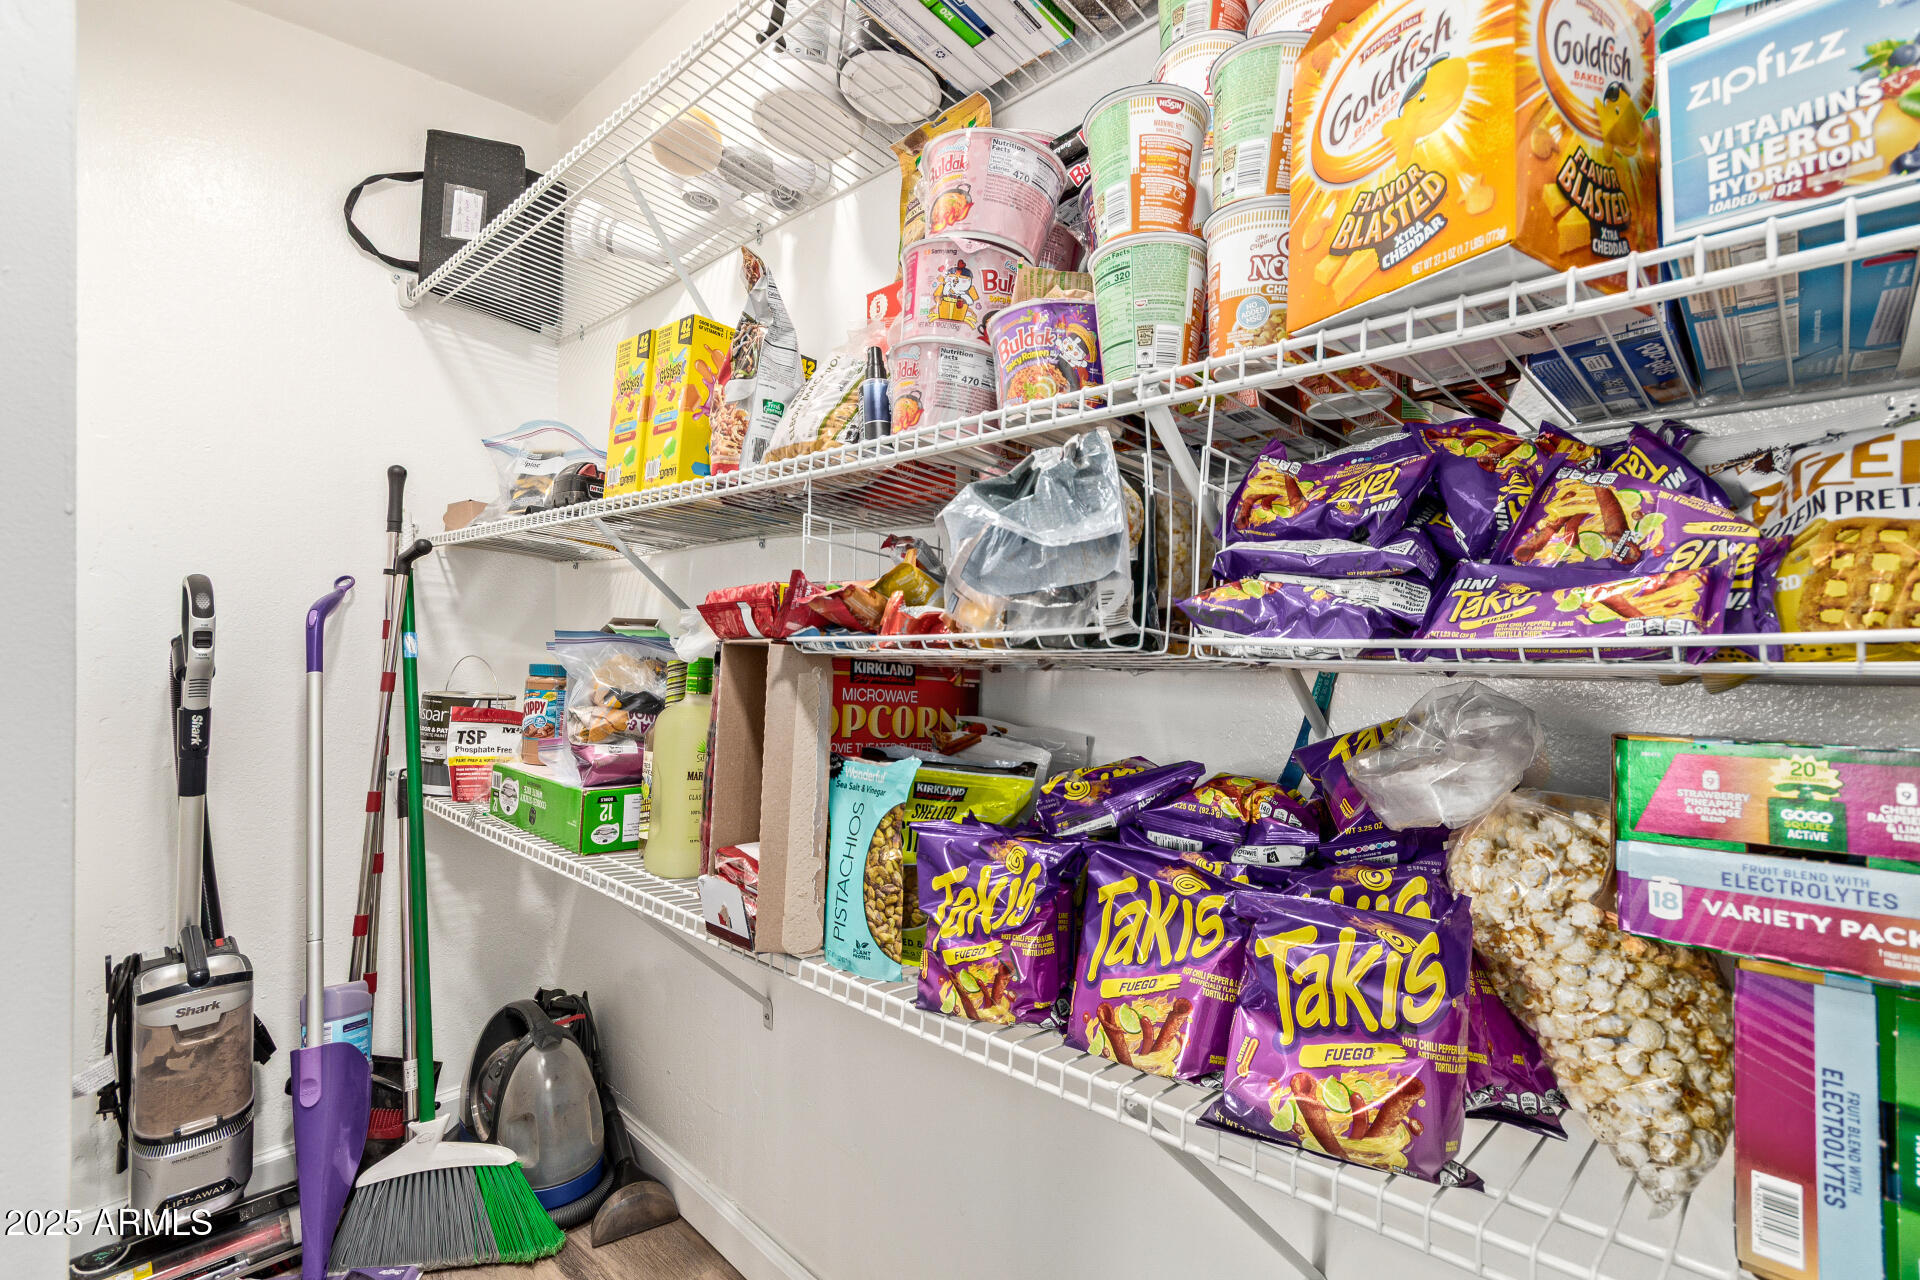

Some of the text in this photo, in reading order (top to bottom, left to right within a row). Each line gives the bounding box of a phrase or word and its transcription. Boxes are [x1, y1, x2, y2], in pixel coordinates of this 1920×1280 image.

[1400, 15, 1421, 32] FARM
[1554, 20, 1633, 82] Goldfish
[1329, 9, 1452, 146] Goldfish
[1574, 70, 1605, 85] BAKED
[1159, 98, 1183, 109] NISSIN
[1354, 92, 1400, 138] BAKED
[1699, 77, 1884, 156] VITAMINS
[991, 144, 1010, 154] Facts
[992, 138, 1026, 153] Nutrition
[1707, 103, 1884, 183] ENERGY
[1012, 170, 1030, 183] 470
[1573, 147, 1618, 189] FLAVOR
[1709, 138, 1875, 202] HYDRATION
[1353, 163, 1424, 213] FLAVOR
[1558, 156, 1630, 226] BLASTED
[1708, 193, 1756, 215] LOADED
[1776, 179, 1803, 198] B12
[1332, 171, 1446, 250] BLASTED
[1382, 215, 1446, 269] CHEDDAR
[1394, 220, 1426, 247] XTRA
[1601, 227, 1619, 241] XTRA
[1592, 238, 1630, 255] CHEDDAR
[1411, 260, 1423, 276] NET
[1423, 257, 1433, 271] WT
[1114, 271, 1130, 282] 320
[876, 300, 881, 312] 5
[1241, 306, 1266, 318] ADDED
[941, 348, 973, 358] Nutrition
[997, 327, 1057, 365] Buldak
[1006, 350, 1050, 373] Spicy Ramen
[961, 376, 980, 386] 470
[1326, 466, 1401, 504] Takis
[1709, 524, 1752, 533] FUEGO
[1451, 575, 1497, 591] MINI
[1449, 588, 1543, 623] Takis
[1481, 612, 1514, 625] FUEGO
[1558, 620, 1574, 628] LIME
[1523, 630, 1542, 638] CHIPS
[853, 660, 914, 677] KIRKLAND
[842, 687, 919, 704] MICROWAVE
[190, 714, 203, 746] Shark
[457, 730, 487, 745] TSP
[455, 746, 495, 754] Phosphate
[845, 766, 888, 783] Wonderful
[1790, 761, 1816, 777] 20
[835, 780, 887, 797] Sea Salt & Vinegar
[1706, 775, 1714, 786] 9
[916, 782, 966, 798] KIRKLAND
[1676, 789, 1751, 803] STRAWBERRY
[1901, 791, 1912, 802] 9
[600, 804, 614, 821] 12
[911, 803, 958, 820] SHELLED
[1187, 804, 1197, 813] OZ
[1260, 804, 1271, 814] 140
[1684, 798, 1743, 811] PINEAPPLE
[1695, 806, 1742, 819] ORANGE
[1345, 821, 1384, 835] WT 3.25 OZ
[1700, 815, 1726, 824] BLEND
[1784, 820, 1833, 832] SQUEEZ
[832, 801, 865, 942] PISTACHIOS
[1742, 863, 1870, 889] FRUIT BLEND WITH
[1652, 889, 1680, 910] 18
[1721, 871, 1899, 911] ELECTROLYTES
[932, 862, 1042, 951] Takis
[1702, 898, 1832, 933] VARIETY
[1087, 876, 1227, 982] Takis
[853, 948, 871, 956] PLANT
[954, 947, 986, 961] FUEGO
[1022, 949, 1044, 957] TORTILLA
[1182, 967, 1193, 977] HOT
[1193, 969, 1207, 981] CHILI
[1207, 972, 1229, 985] PEPPER
[1118, 978, 1158, 993] FUEGO
[1189, 977, 1223, 993] ARTIFICIALLY
[1255, 925, 1446, 1046] Takis
[1202, 987, 1229, 1001] TORTILLA
[175, 1000, 221, 1019] Shark
[1324, 1046, 1376, 1062] FUEGO
[1402, 1036, 1457, 1055] HOT CHILI PEPPER
[1418, 1050, 1452, 1062] ARTIFICIALLY
[1435, 1061, 1458, 1074] TORTILLA
[1822, 1067, 1847, 1210] ELECTROLYTES
[1847, 1091, 1863, 1197] FRUIT BLEND WITH
[164, 1183, 227, 1210] LIFT-AWAY
